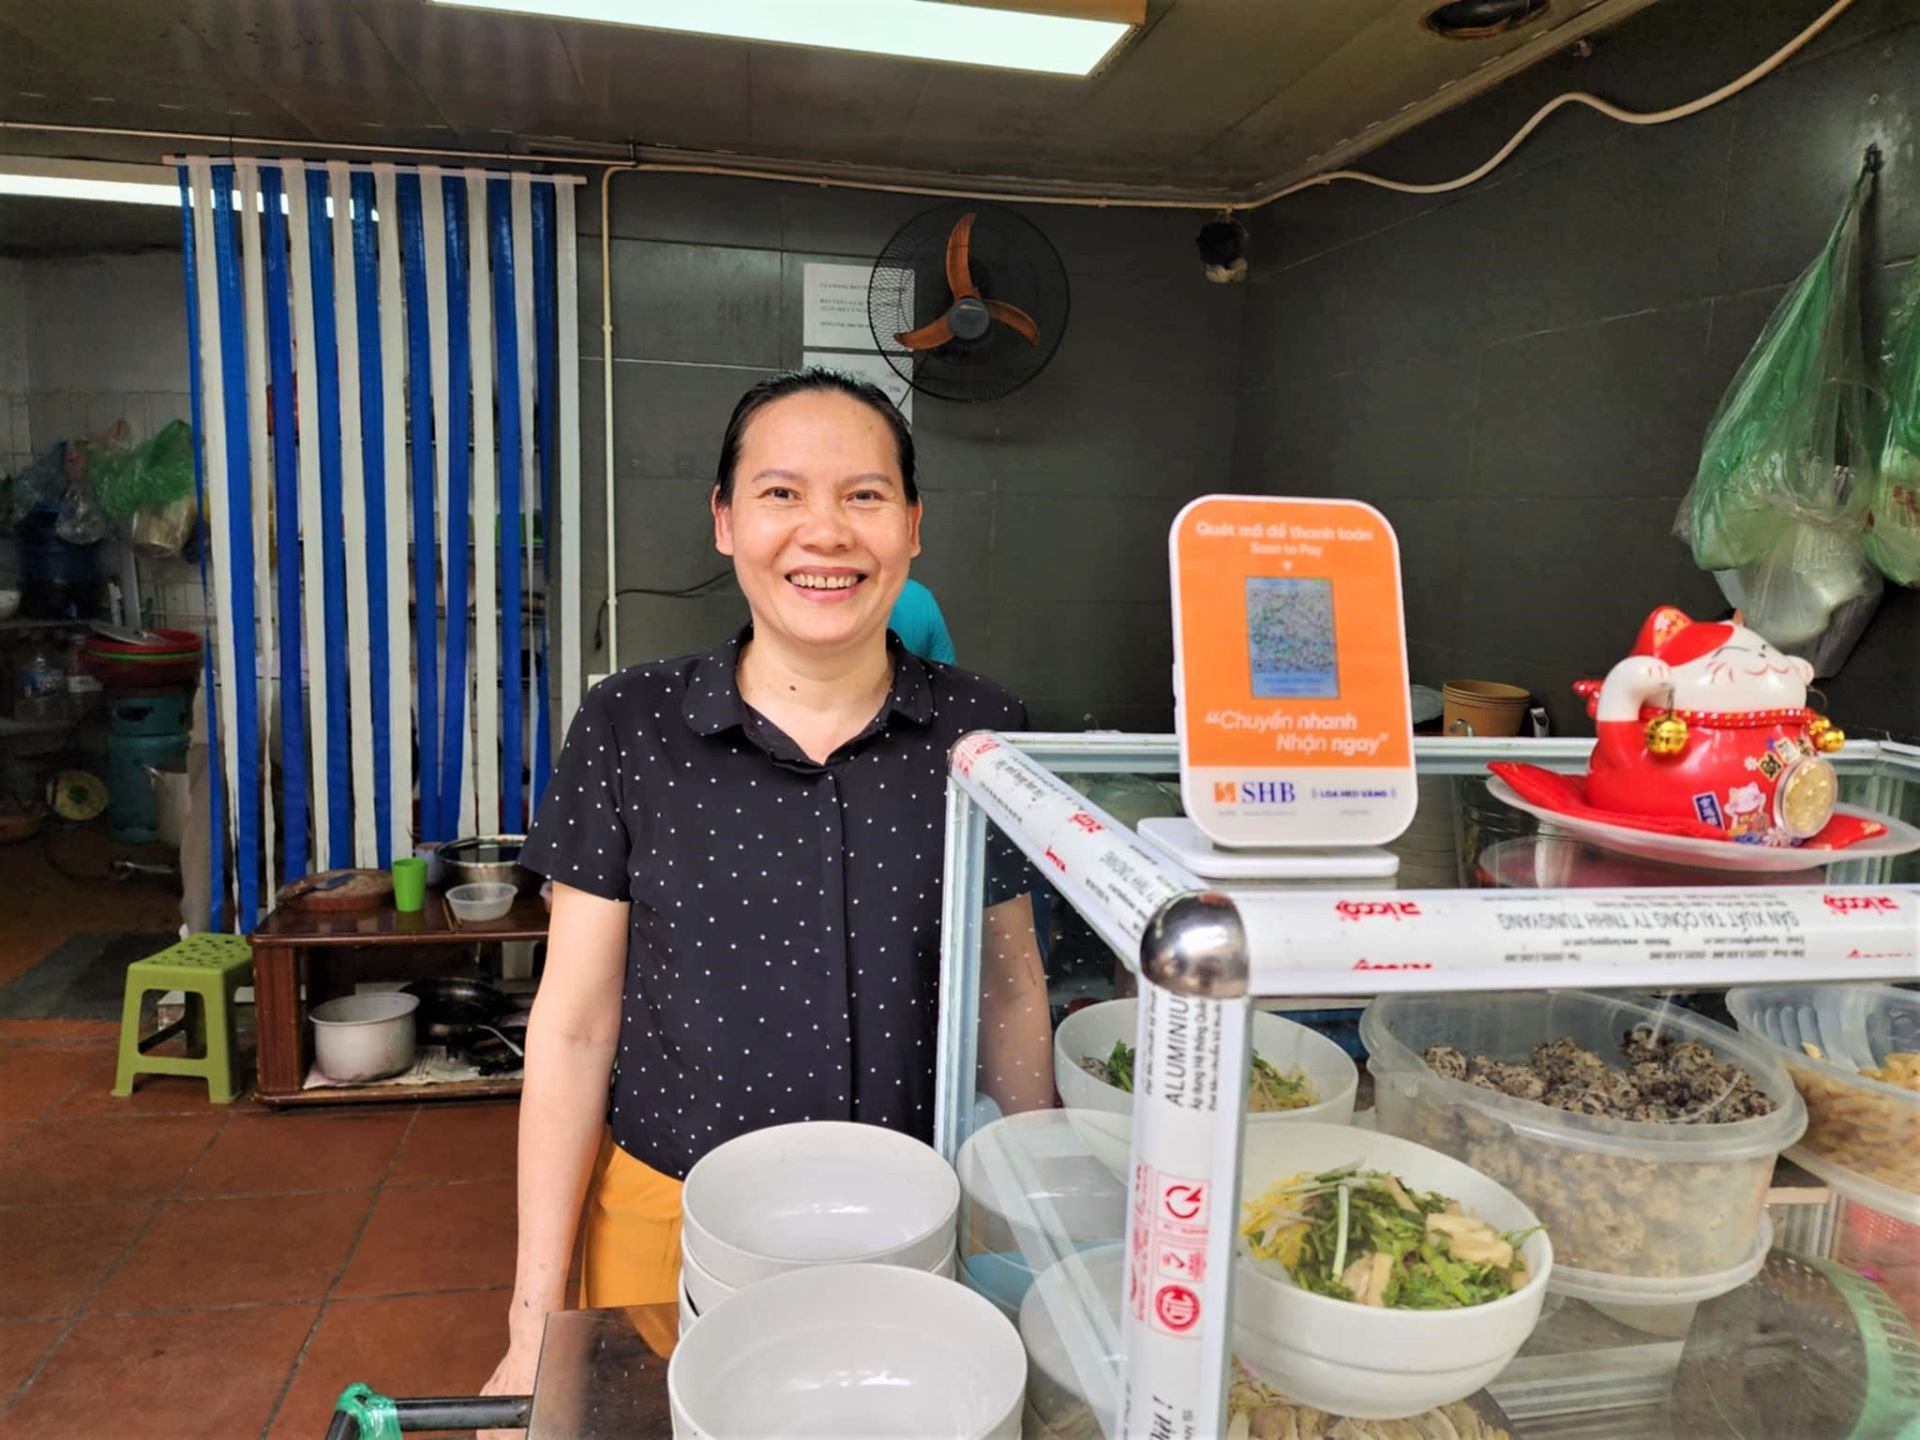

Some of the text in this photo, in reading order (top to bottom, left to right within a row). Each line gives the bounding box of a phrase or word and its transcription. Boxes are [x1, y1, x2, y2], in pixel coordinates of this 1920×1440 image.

[1195, 521, 1235, 538] Quét
[1239, 523, 1264, 538] mã
[1290, 525, 1335, 540] thanh
[1337, 525, 1373, 541] toán
[1250, 541, 1323, 557] Scan to Pay
[1296, 712, 1358, 730] nhanh
[1276, 733, 1327, 755] Nhận
[1242, 781, 1296, 804] SHB
[1498, 912, 1586, 930] TUNGYANG
[1584, 911, 1630, 929] TNHH
[1633, 911, 1653, 928] TY
[1164, 990, 1189, 1108] ALUMINIU
